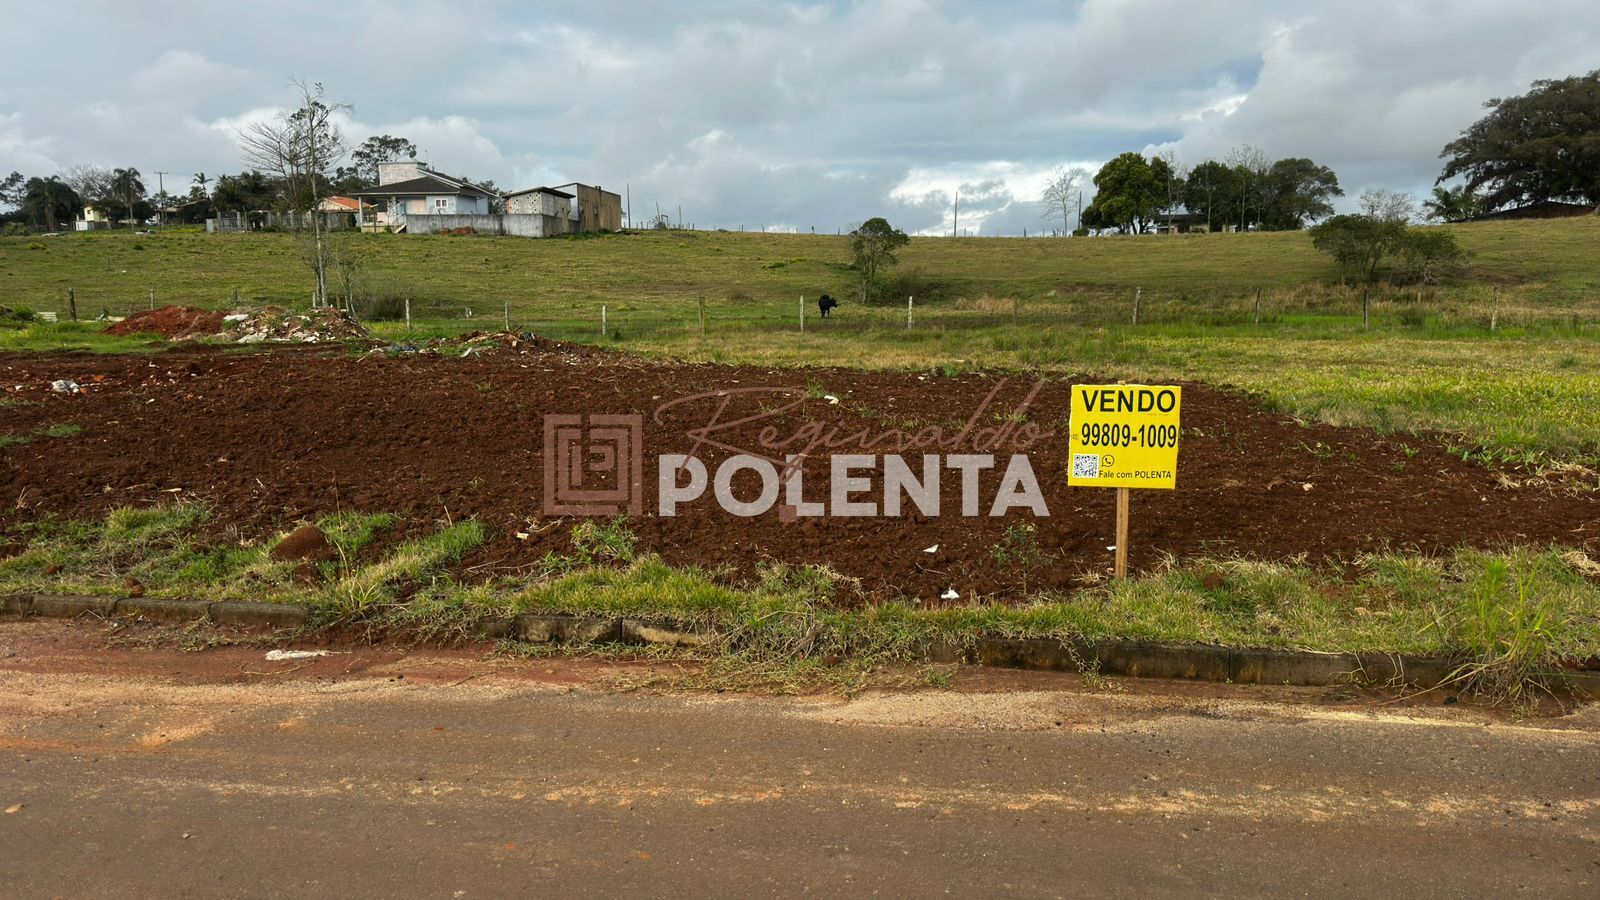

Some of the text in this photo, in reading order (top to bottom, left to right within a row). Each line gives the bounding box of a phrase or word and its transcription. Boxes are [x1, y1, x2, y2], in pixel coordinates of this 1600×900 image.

[1081, 389, 1176, 413] VENDO
[1081, 422, 1177, 448] 99809-1009
[1098, 470, 1115, 479] Fale
[1134, 470, 1172, 479] POLENTA
